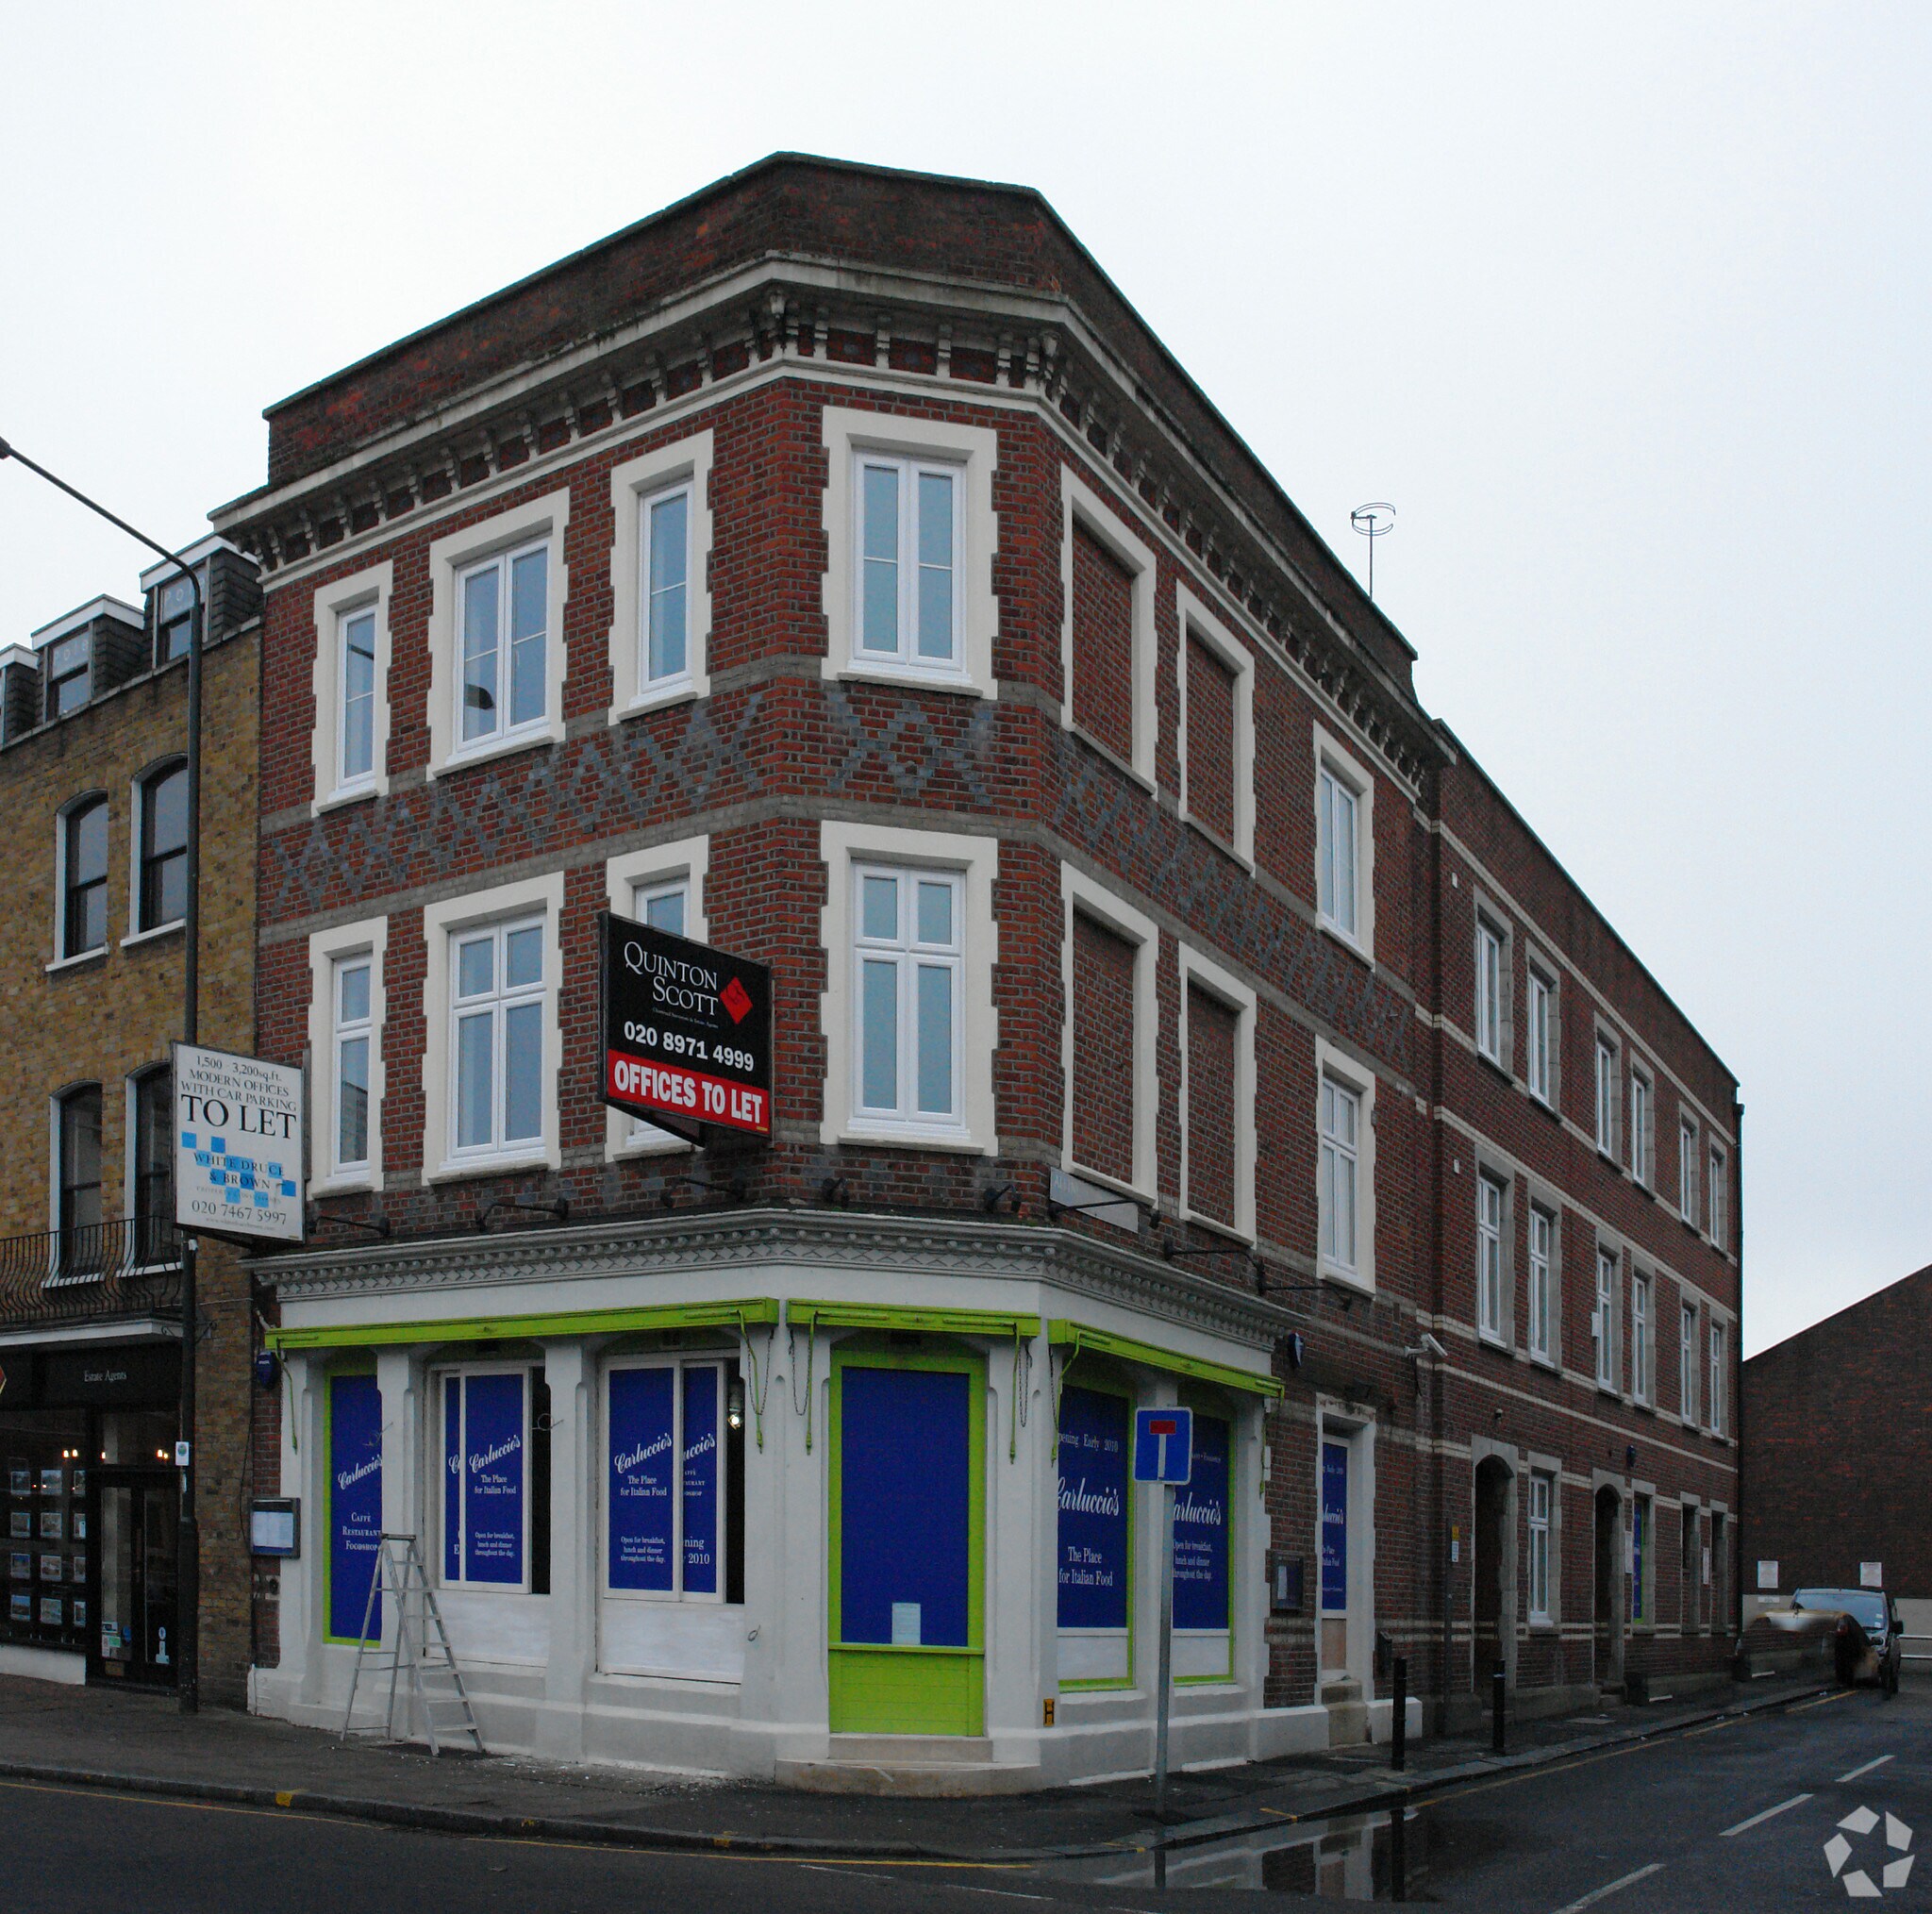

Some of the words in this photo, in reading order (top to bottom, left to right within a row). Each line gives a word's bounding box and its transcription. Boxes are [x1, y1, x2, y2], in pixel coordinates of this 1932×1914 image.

[624, 940, 717, 991] QUINTON
[652, 975, 719, 1017] SCOTT
[624, 1020, 658, 1047] 020
[662, 1031, 708, 1060] 8971
[712, 1044, 754, 1073] 4999
[197, 1056, 223, 1070] 1,500
[190, 1069, 241, 1088] MODERN
[243, 1079, 289, 1097] OFFICES
[614, 1059, 696, 1108] OFFICES
[701, 1080, 725, 1115] TO
[730, 1089, 762, 1124] LET
[181, 1080, 214, 1096] WITH
[217, 1088, 242, 1102] CAR
[245, 1094, 297, 1112] PARKING
[180, 1093, 229, 1127] TO
[239, 1104, 297, 1140] LET
[193, 1152, 237, 1169] WHITE
[241, 1159, 285, 1176] DRUCE
[209, 1172, 217, 1182] &
[223, 1173, 271, 1190] BROWN
[192, 1199, 216, 1215] 020
[220, 1204, 253, 1220] 7467
[257, 1208, 287, 1225] 5997
[84, 1370, 103, 1382] Estate
[104, 1369, 127, 1384] Agents
[469, 1434, 521, 1473] Carluccio's
[614, 1432, 673, 1474] Carluccio's
[337, 1454, 383, 1490] Carluccio's
[480, 1474, 491, 1483] The
[491, 1473, 508, 1483] Place
[627, 1474, 640, 1485] The
[641, 1474, 658, 1485] Place
[474, 1485, 483, 1494] for
[483, 1485, 502, 1494] Italian
[502, 1485, 517, 1494] Food
[620, 1487, 629, 1496] for
[630, 1487, 650, 1496] Italian
[651, 1486, 667, 1496] Food
[1174, 1491, 1222, 1525] arluccio's
[345, 1540, 378, 1551] FOODSHOP
[1067, 1546, 1082, 1562] The
[1083, 1547, 1103, 1564] Place
[688, 1553, 710, 1565] 2010
[1058, 1567, 1070, 1584] for
[1071, 1568, 1094, 1585] Italian
[1095, 1570, 1113, 1587] Food
